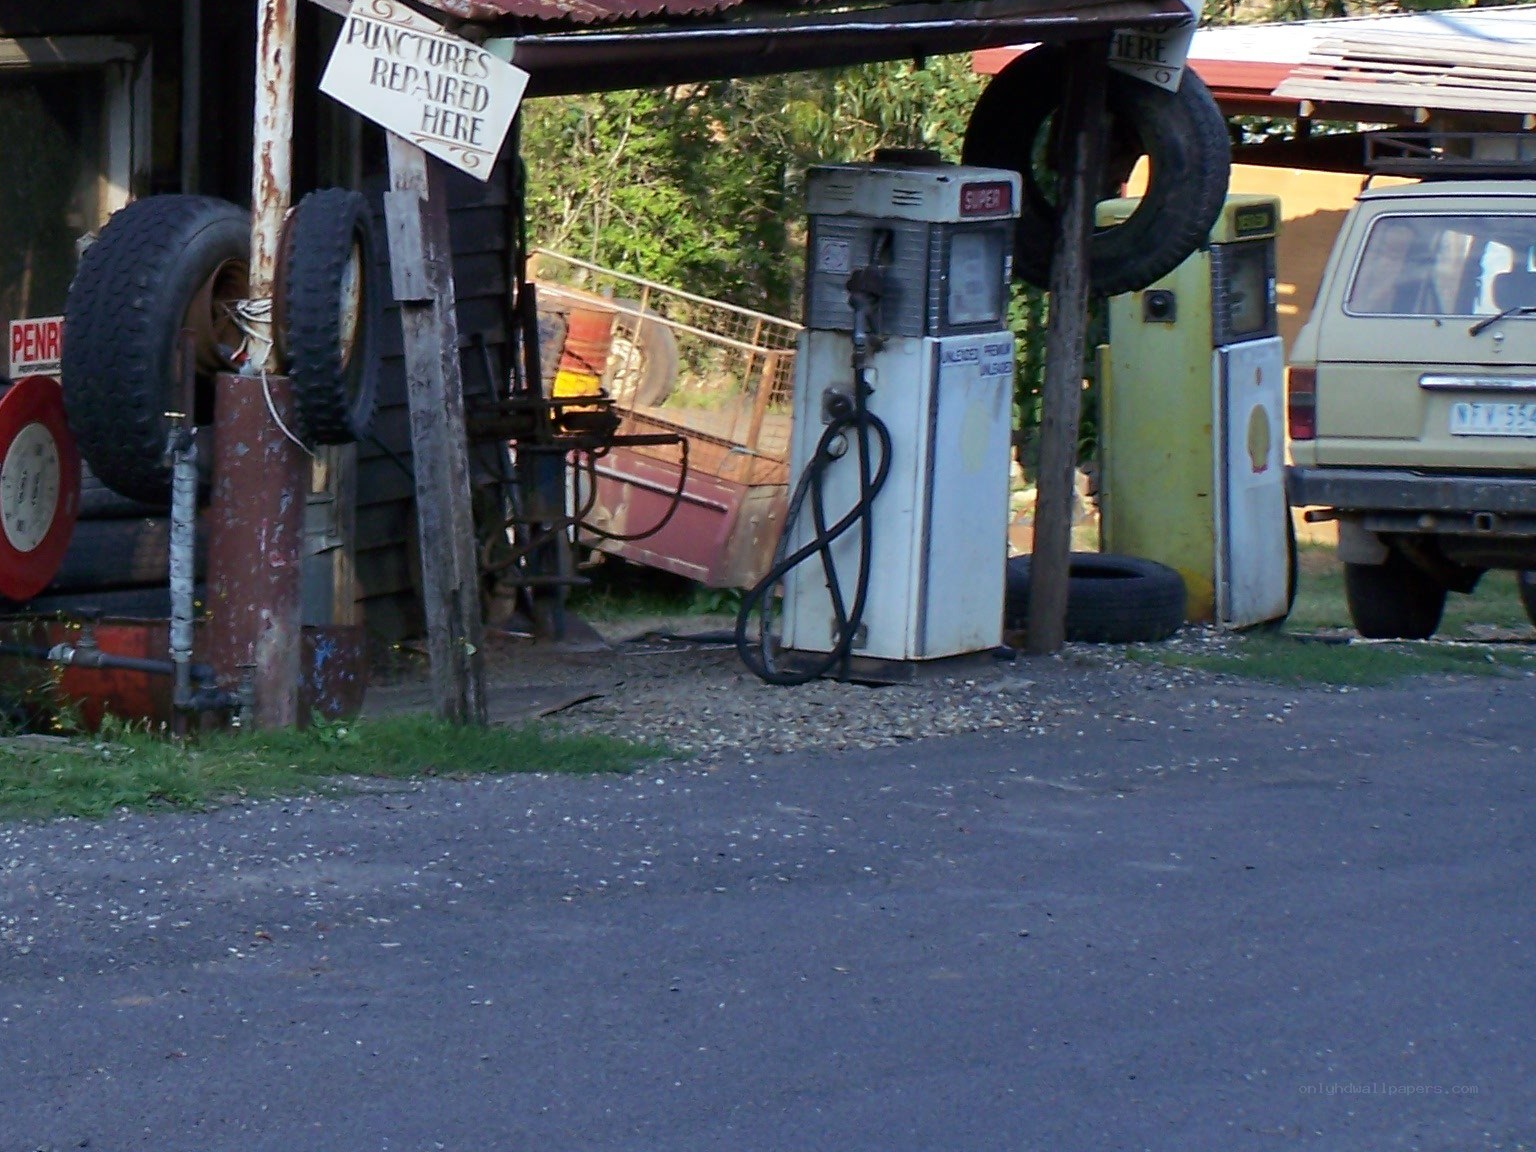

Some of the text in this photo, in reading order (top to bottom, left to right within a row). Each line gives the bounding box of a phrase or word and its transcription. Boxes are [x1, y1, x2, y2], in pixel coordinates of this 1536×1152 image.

[346, 17, 492, 79] PUNCTURES
[369, 57, 490, 112] REPAIRED
[421, 104, 485, 146] HERE
